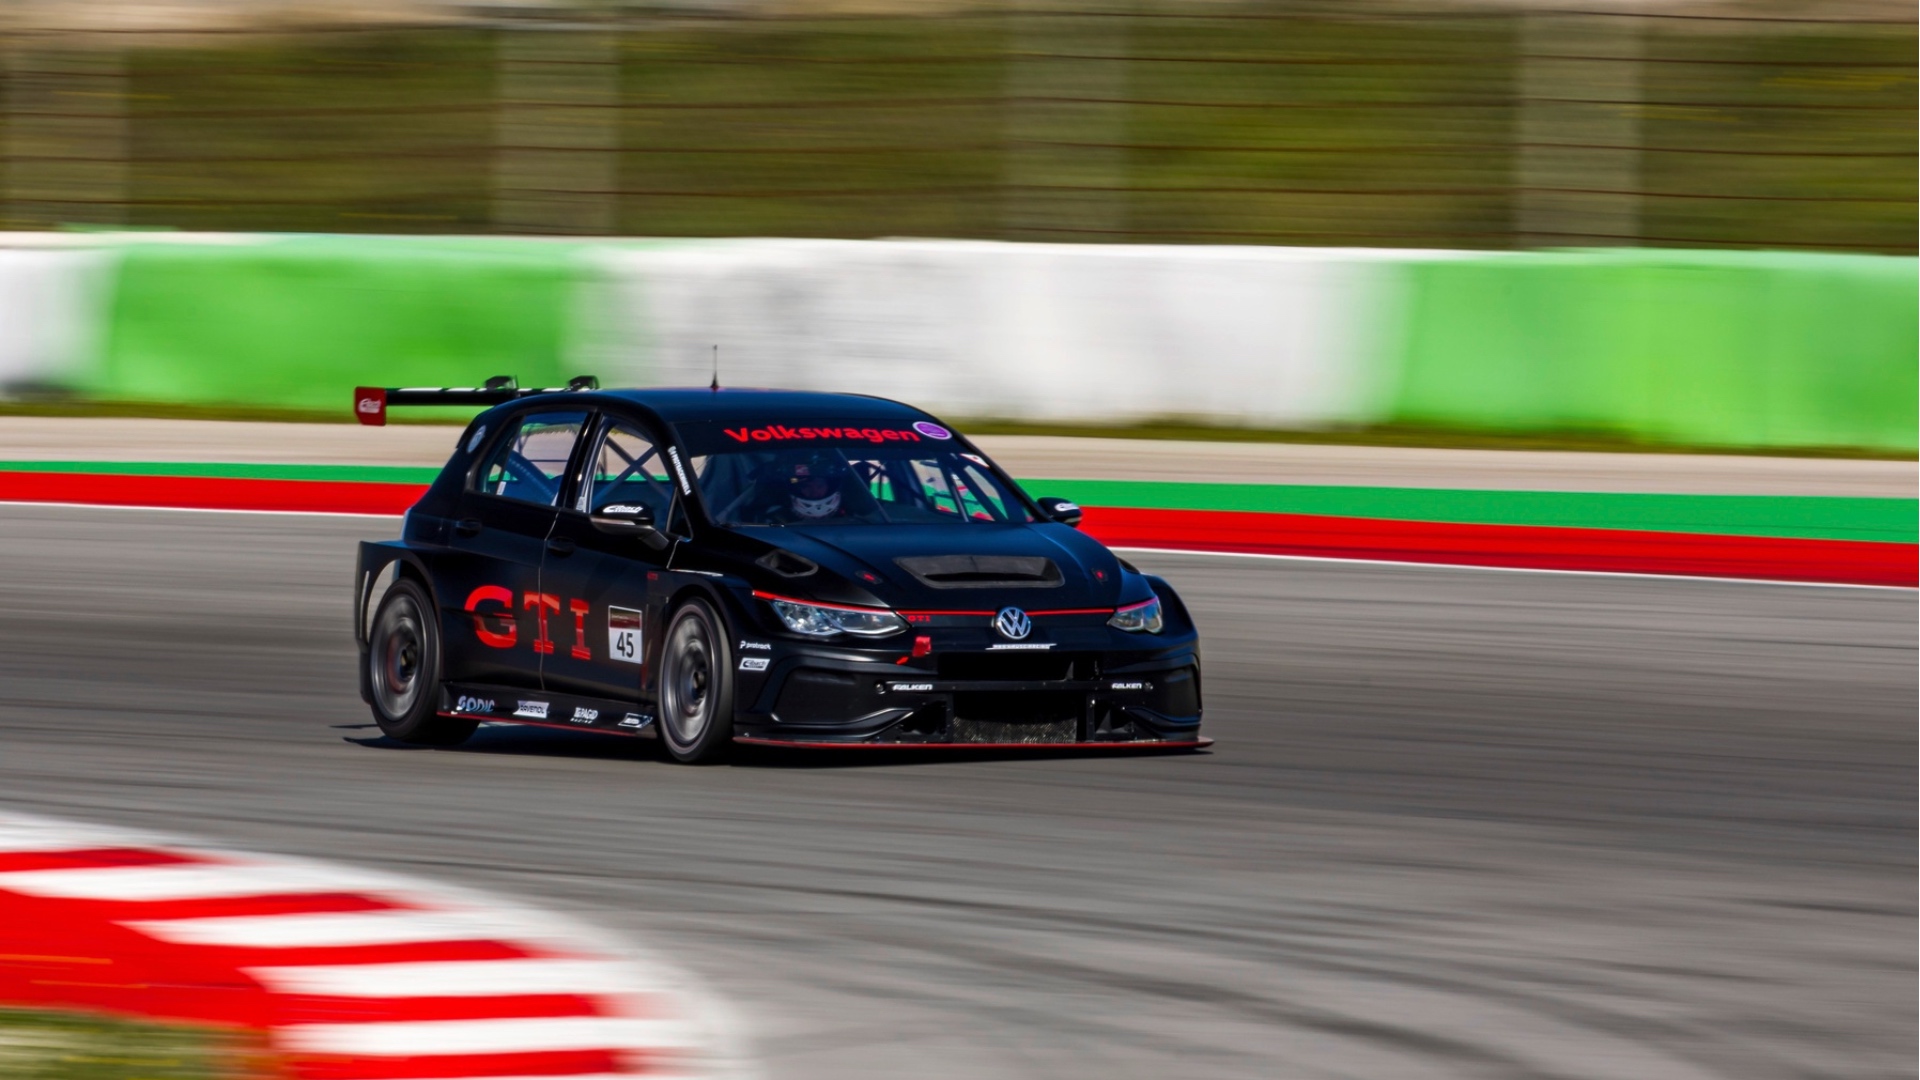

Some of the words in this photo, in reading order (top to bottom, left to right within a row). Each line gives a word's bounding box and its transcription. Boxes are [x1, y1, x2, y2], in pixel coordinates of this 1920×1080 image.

[724, 425, 921, 443] Volkswagen
[464, 585, 591, 660] GTI
[616, 631, 634, 658] 45
[892, 683, 932, 691] FALKEN
[1111, 682, 1142, 690] FALKEN
